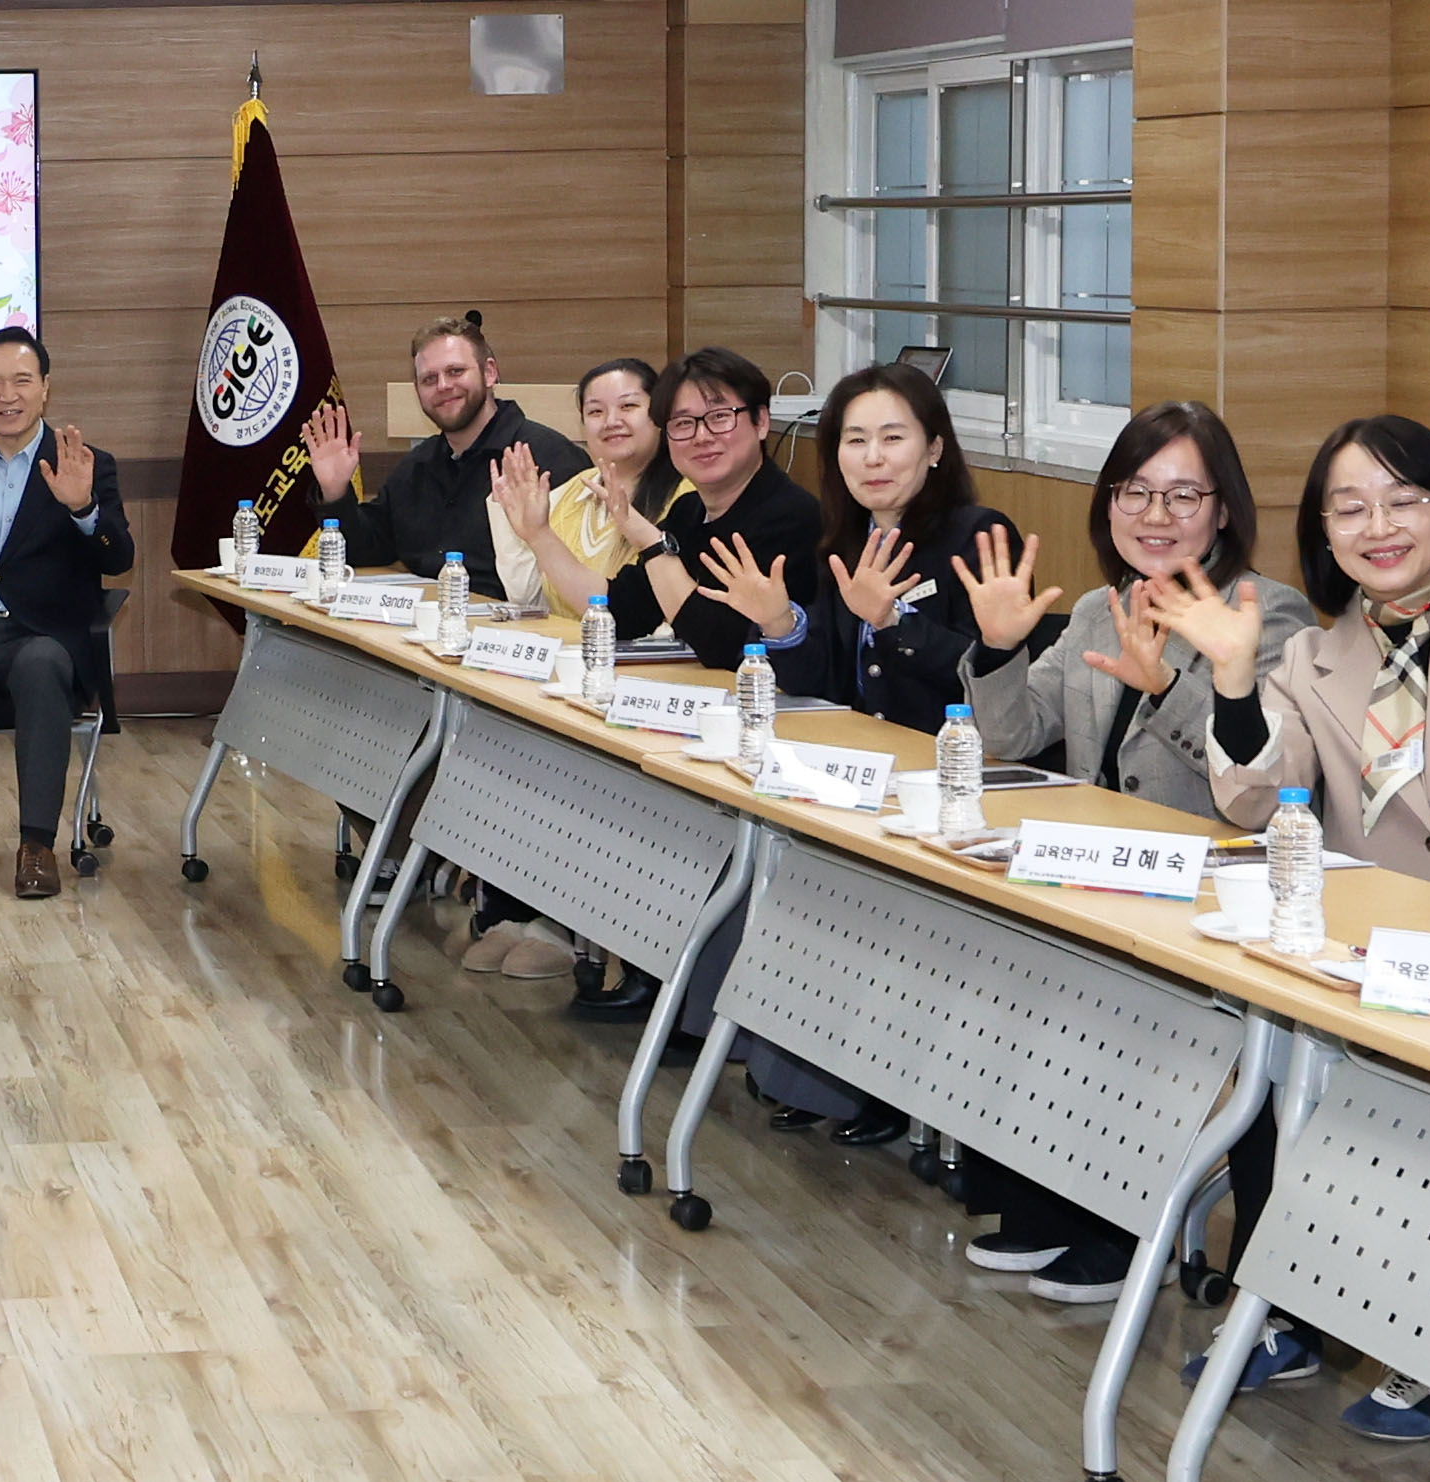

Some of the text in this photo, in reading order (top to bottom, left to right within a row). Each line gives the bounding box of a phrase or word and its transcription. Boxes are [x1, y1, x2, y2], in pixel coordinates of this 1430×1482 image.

[239, 299, 276, 328] EDUCATION
[212, 314, 274, 420] GIGE
[294, 565, 308, 579] Va
[379, 593, 414, 610] Sandra
[620, 694, 662, 712] 교육연구사
[1033, 843, 1186, 873] 교육연구사 김혜숙
